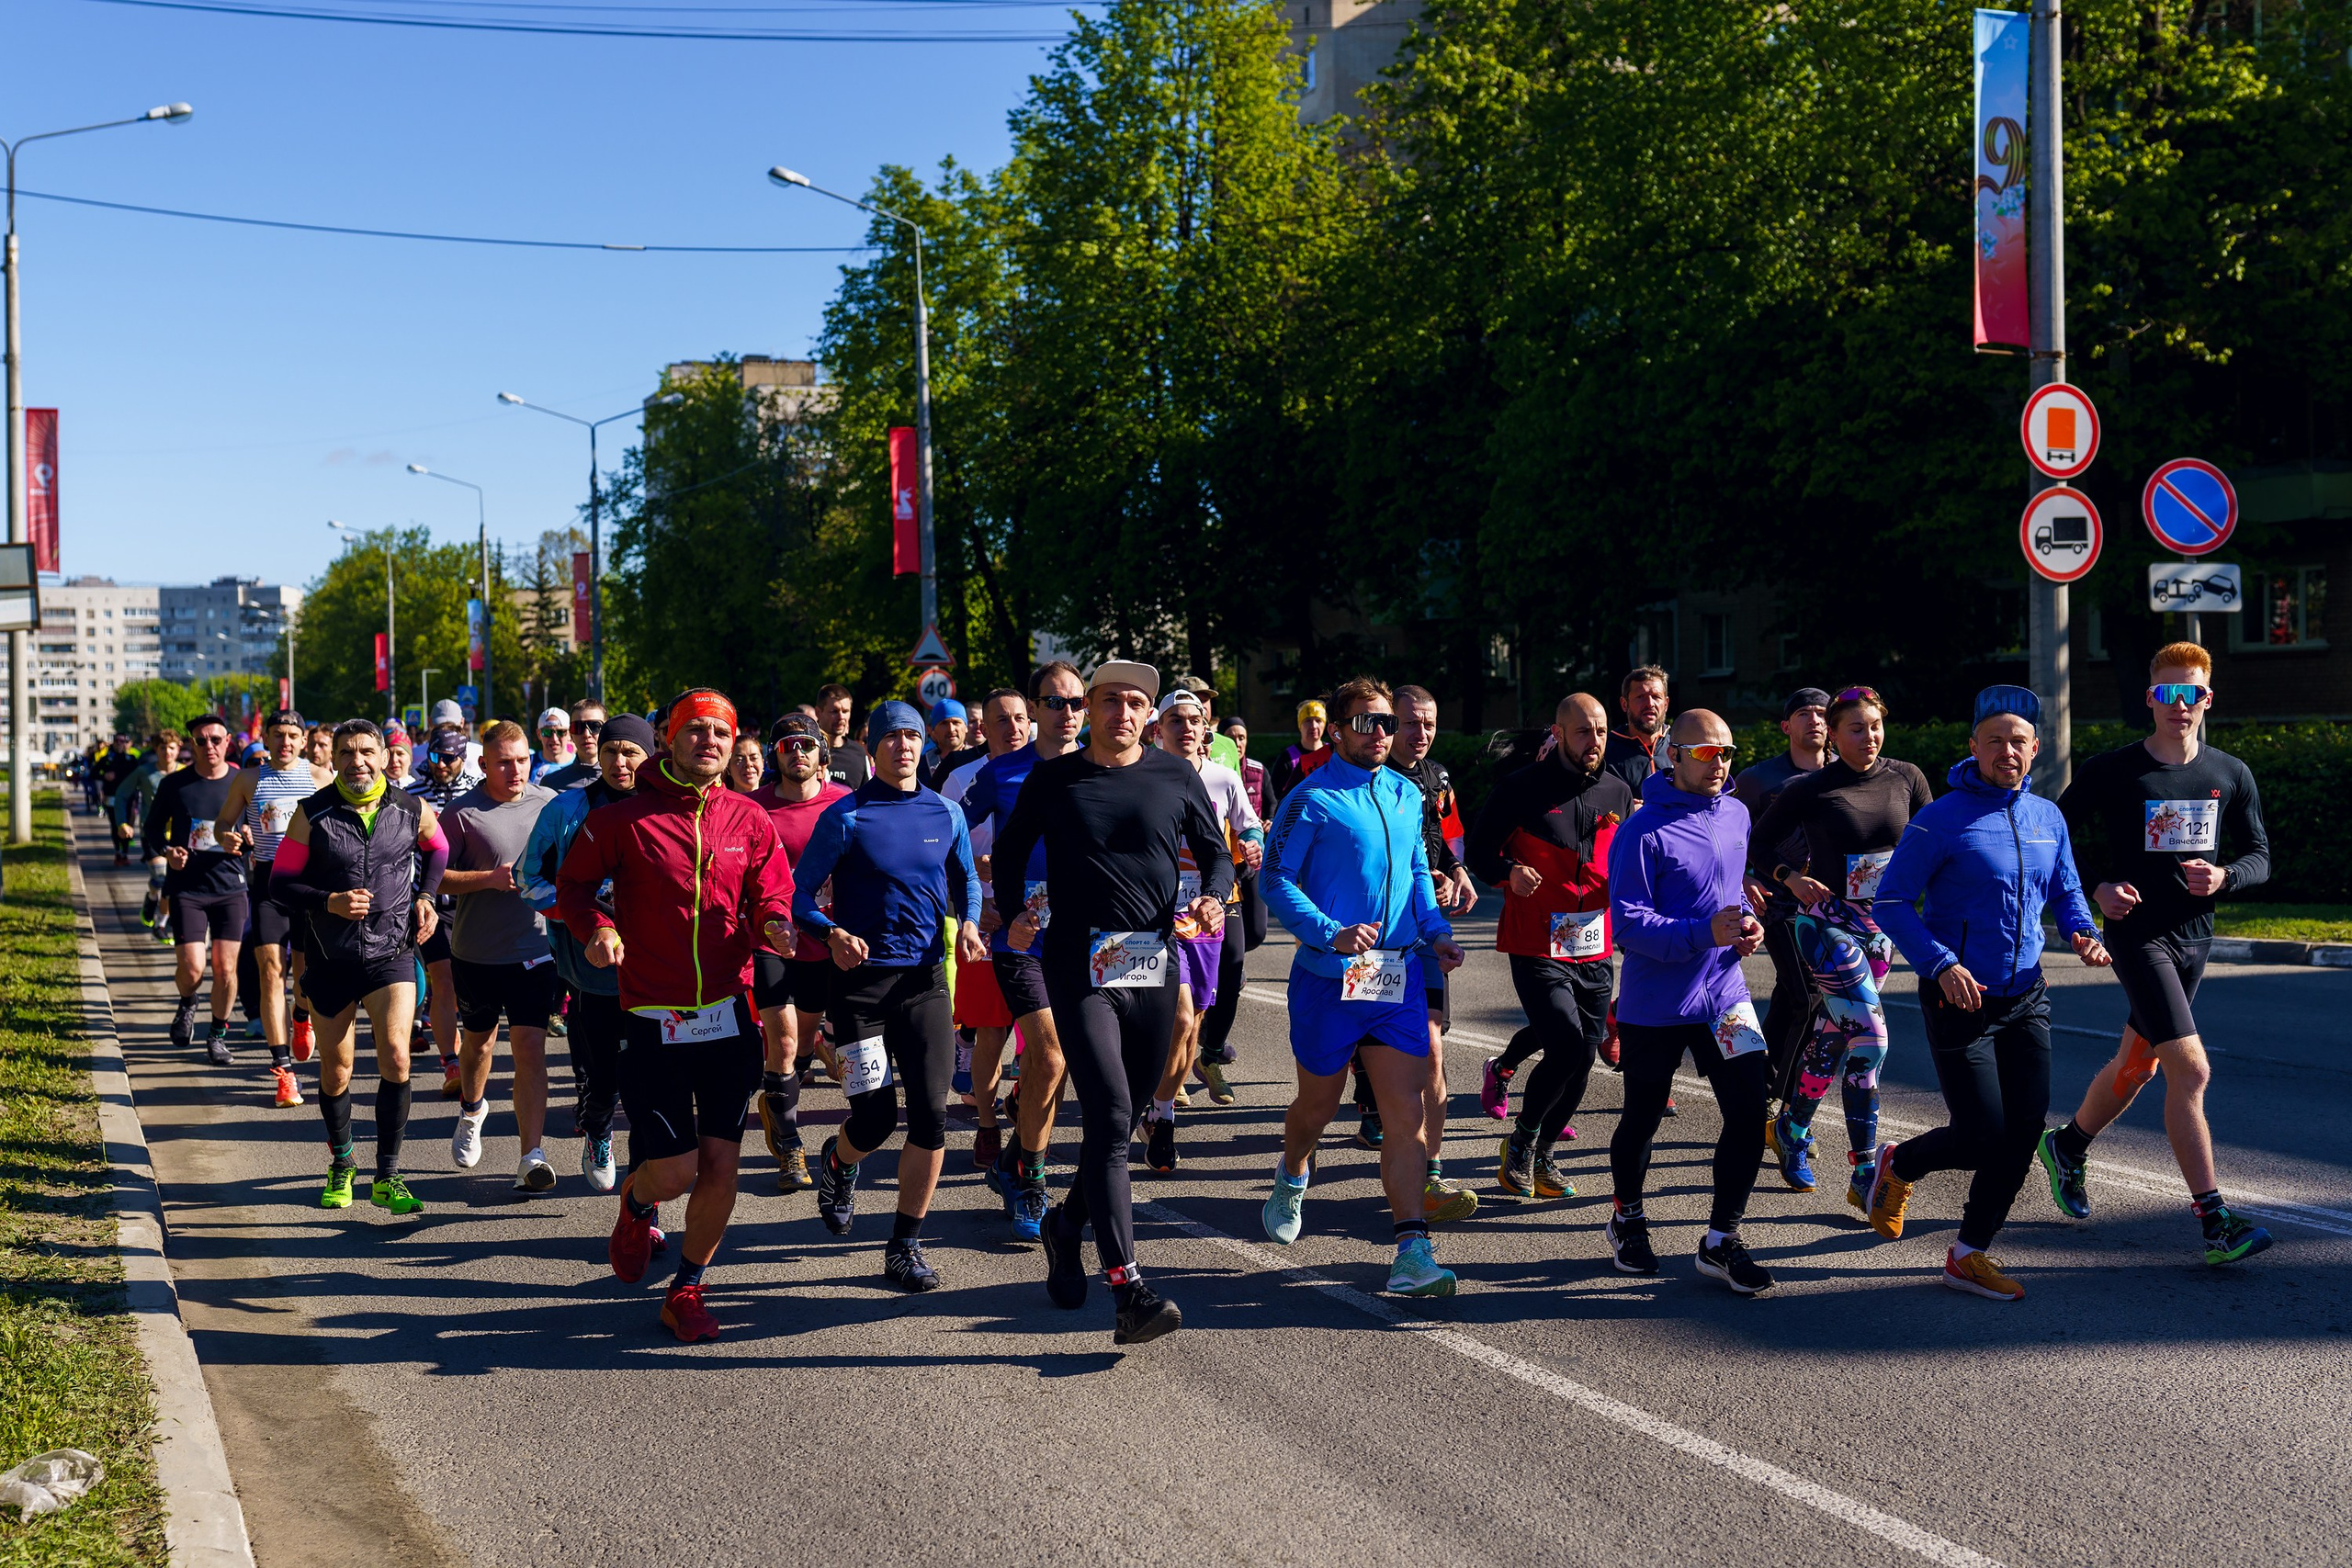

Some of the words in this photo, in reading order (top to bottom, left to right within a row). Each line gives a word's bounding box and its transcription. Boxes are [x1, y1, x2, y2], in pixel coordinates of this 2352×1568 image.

[923, 681, 947, 697] 40
[2186, 821, 2209, 835] 121
[2169, 837, 2208, 845] Вячеслав
[1182, 887, 1197, 898] 16
[1585, 929, 1600, 942] 88
[1129, 955, 1159, 970] 110
[1119, 973, 1148, 982] Игорь
[1376, 973, 1401, 987] 104
[1361, 987, 1394, 997] Ярослав
[691, 1024, 723, 1037] Сергей
[846, 1048, 863, 1056] СПОРТ
[860, 1059, 880, 1077] 54
[849, 1076, 881, 1089] Степан
